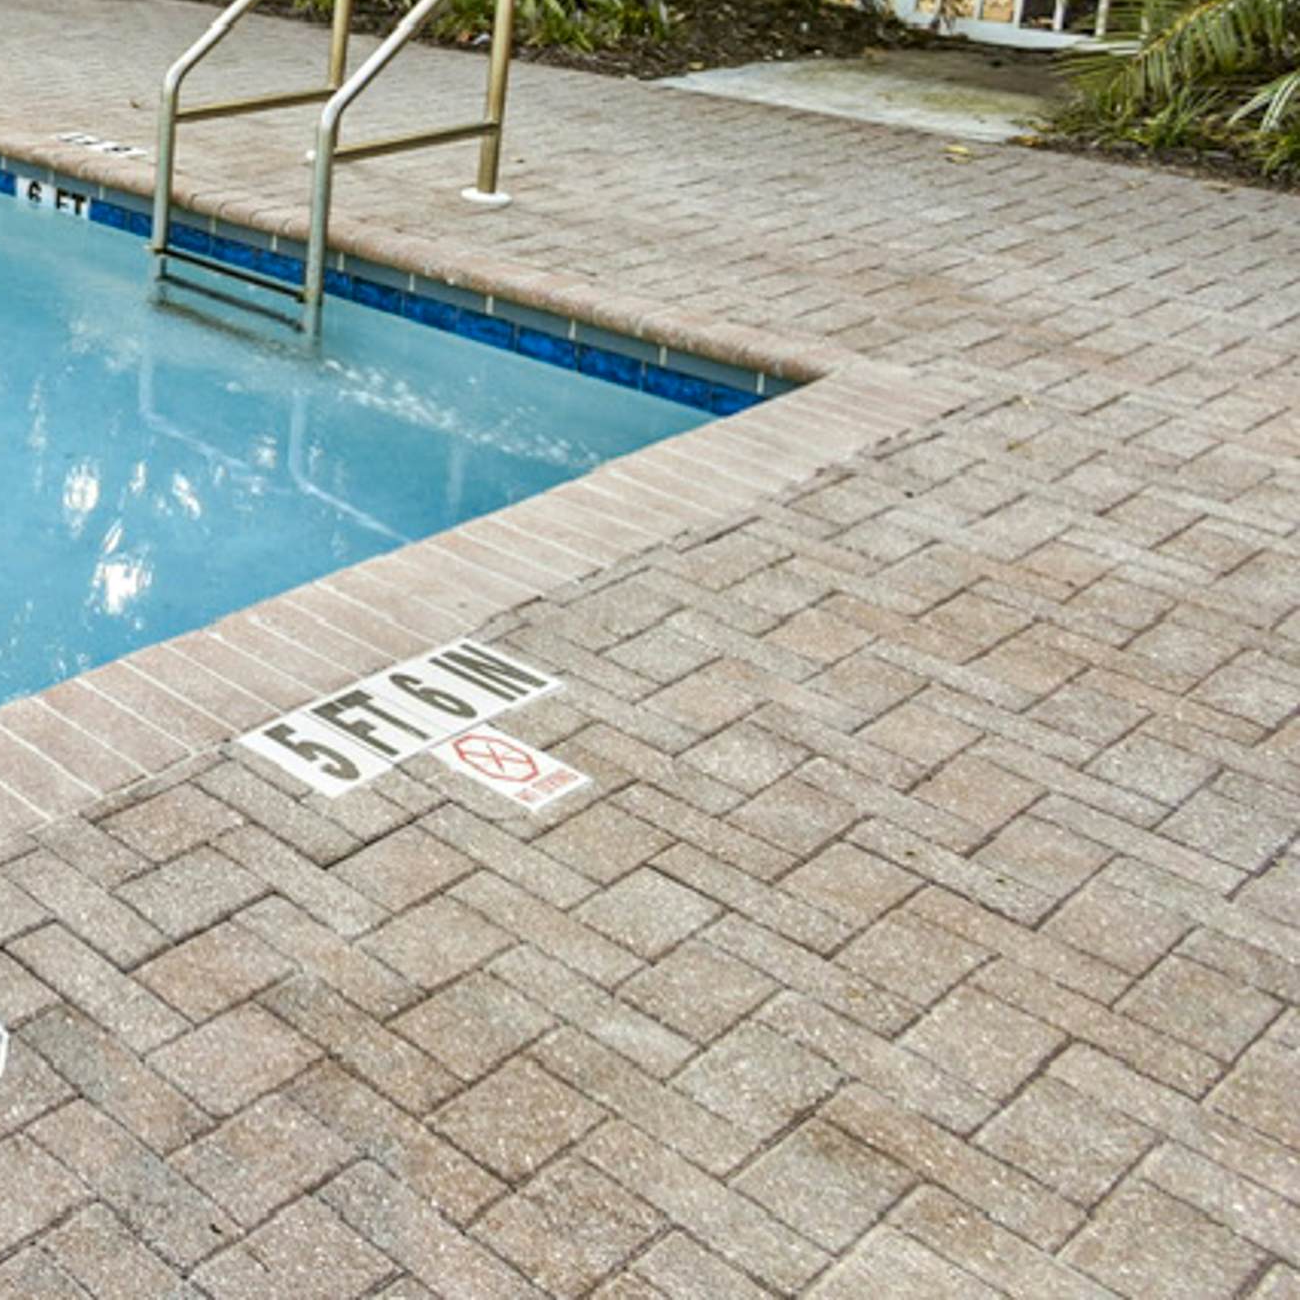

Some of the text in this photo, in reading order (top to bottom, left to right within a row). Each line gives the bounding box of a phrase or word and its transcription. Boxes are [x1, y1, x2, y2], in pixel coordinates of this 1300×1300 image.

[28, 181, 85, 215] 6 FT
[262, 642, 549, 782] 5 FT 6 IN
